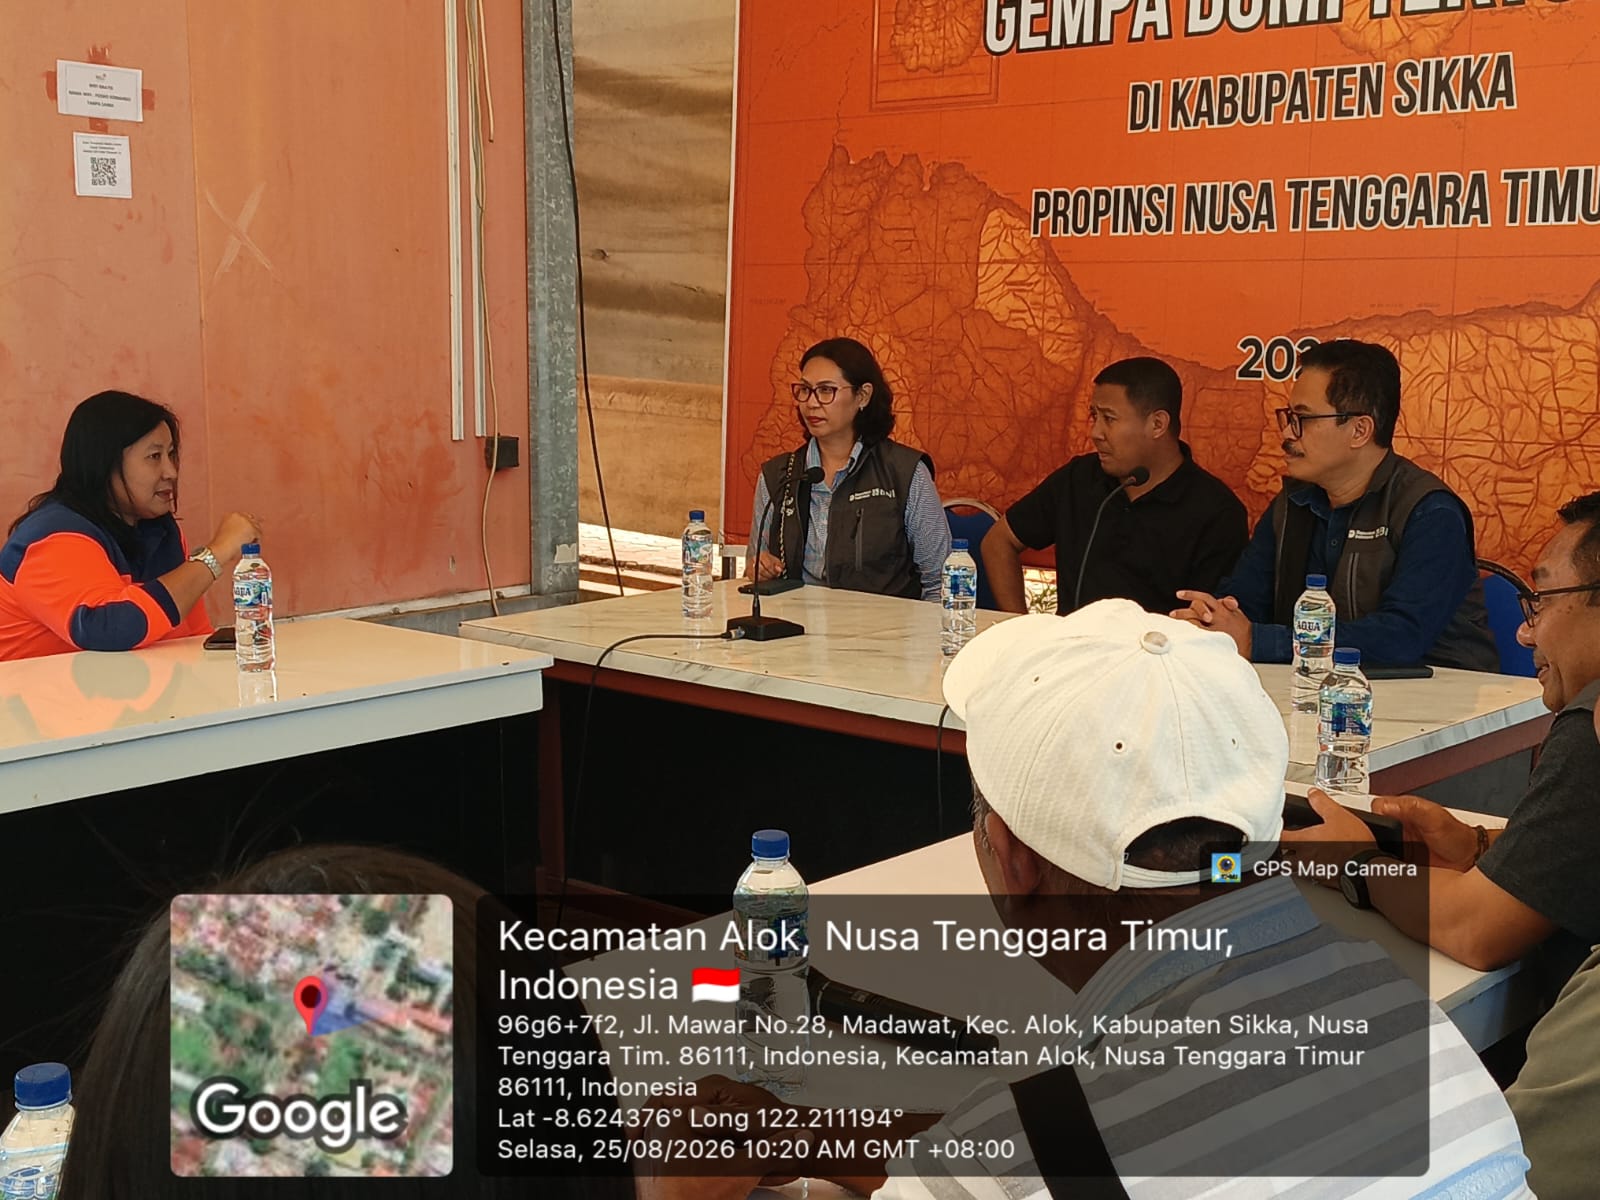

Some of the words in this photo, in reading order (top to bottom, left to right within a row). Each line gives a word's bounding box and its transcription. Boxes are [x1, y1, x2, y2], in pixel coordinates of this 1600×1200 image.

[1128, 81, 1163, 133] DI
[1169, 62, 1385, 131] KABUPATEN
[1393, 52, 1517, 116] SIKKA
[1031, 183, 1176, 237] PROPINSI
[1182, 179, 1277, 234] NUSA
[1286, 170, 1491, 232] TENGGARA
